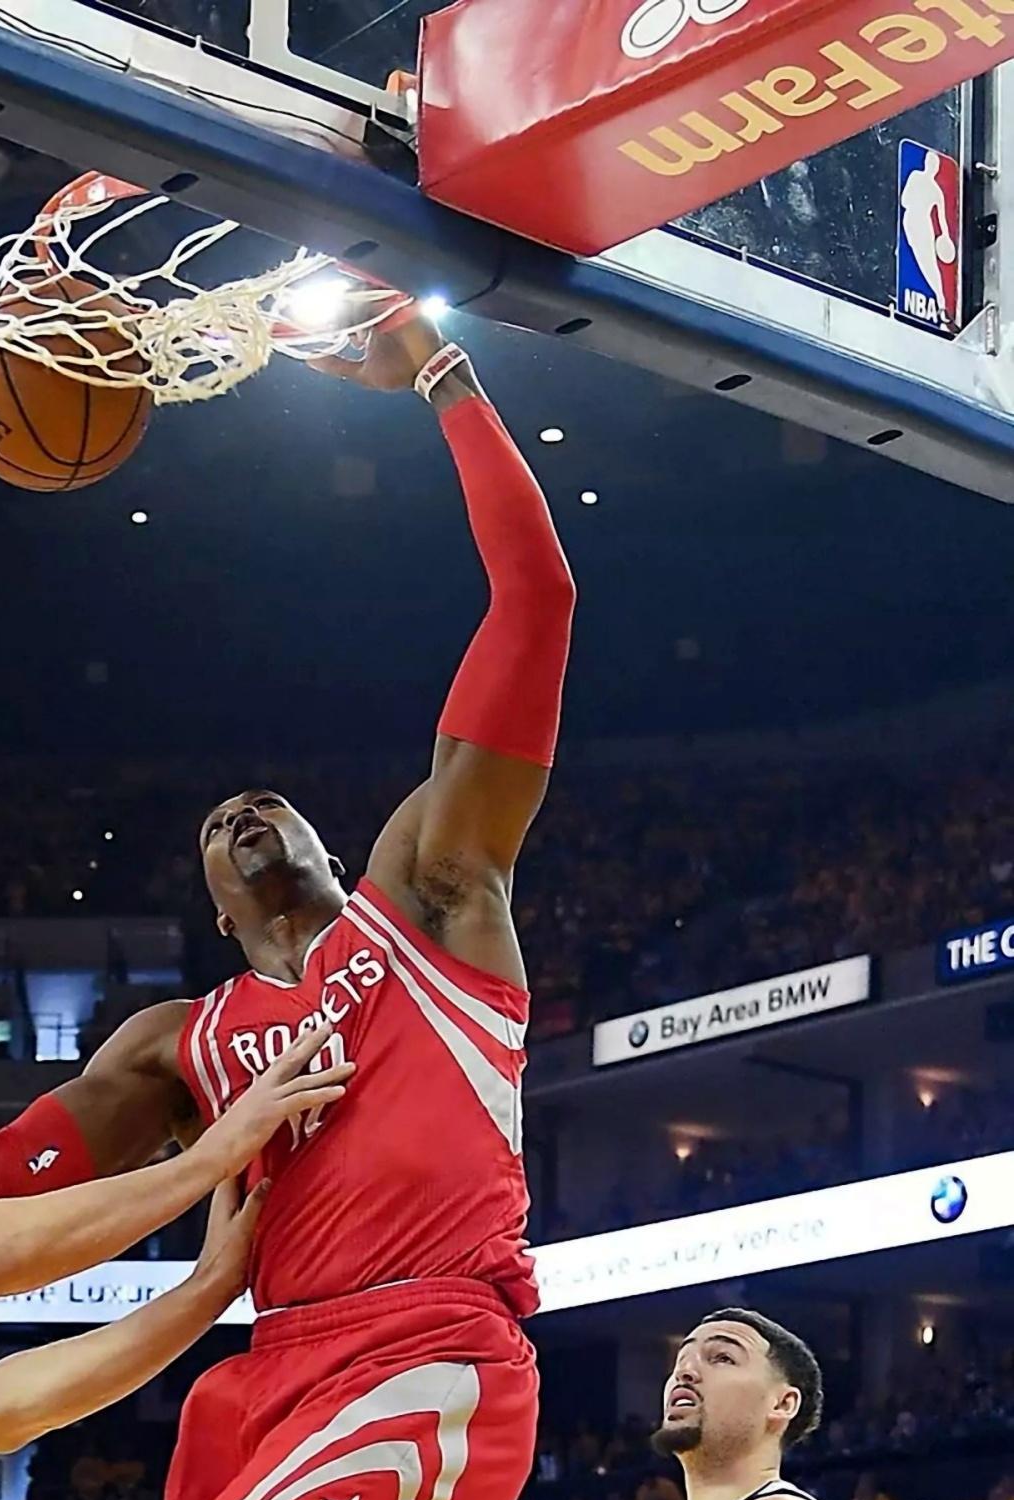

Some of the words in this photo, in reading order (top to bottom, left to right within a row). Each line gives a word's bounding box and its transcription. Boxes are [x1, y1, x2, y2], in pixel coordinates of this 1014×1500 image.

[617, 0, 1014, 176] teFarm
[904, 288, 938, 324] NBA
[946, 930, 998, 971] THE
[661, 1015, 702, 1042] Bay
[708, 1000, 760, 1027] Area
[768, 976, 831, 1013] BMW
[69, 1281, 167, 1303] Luxur
